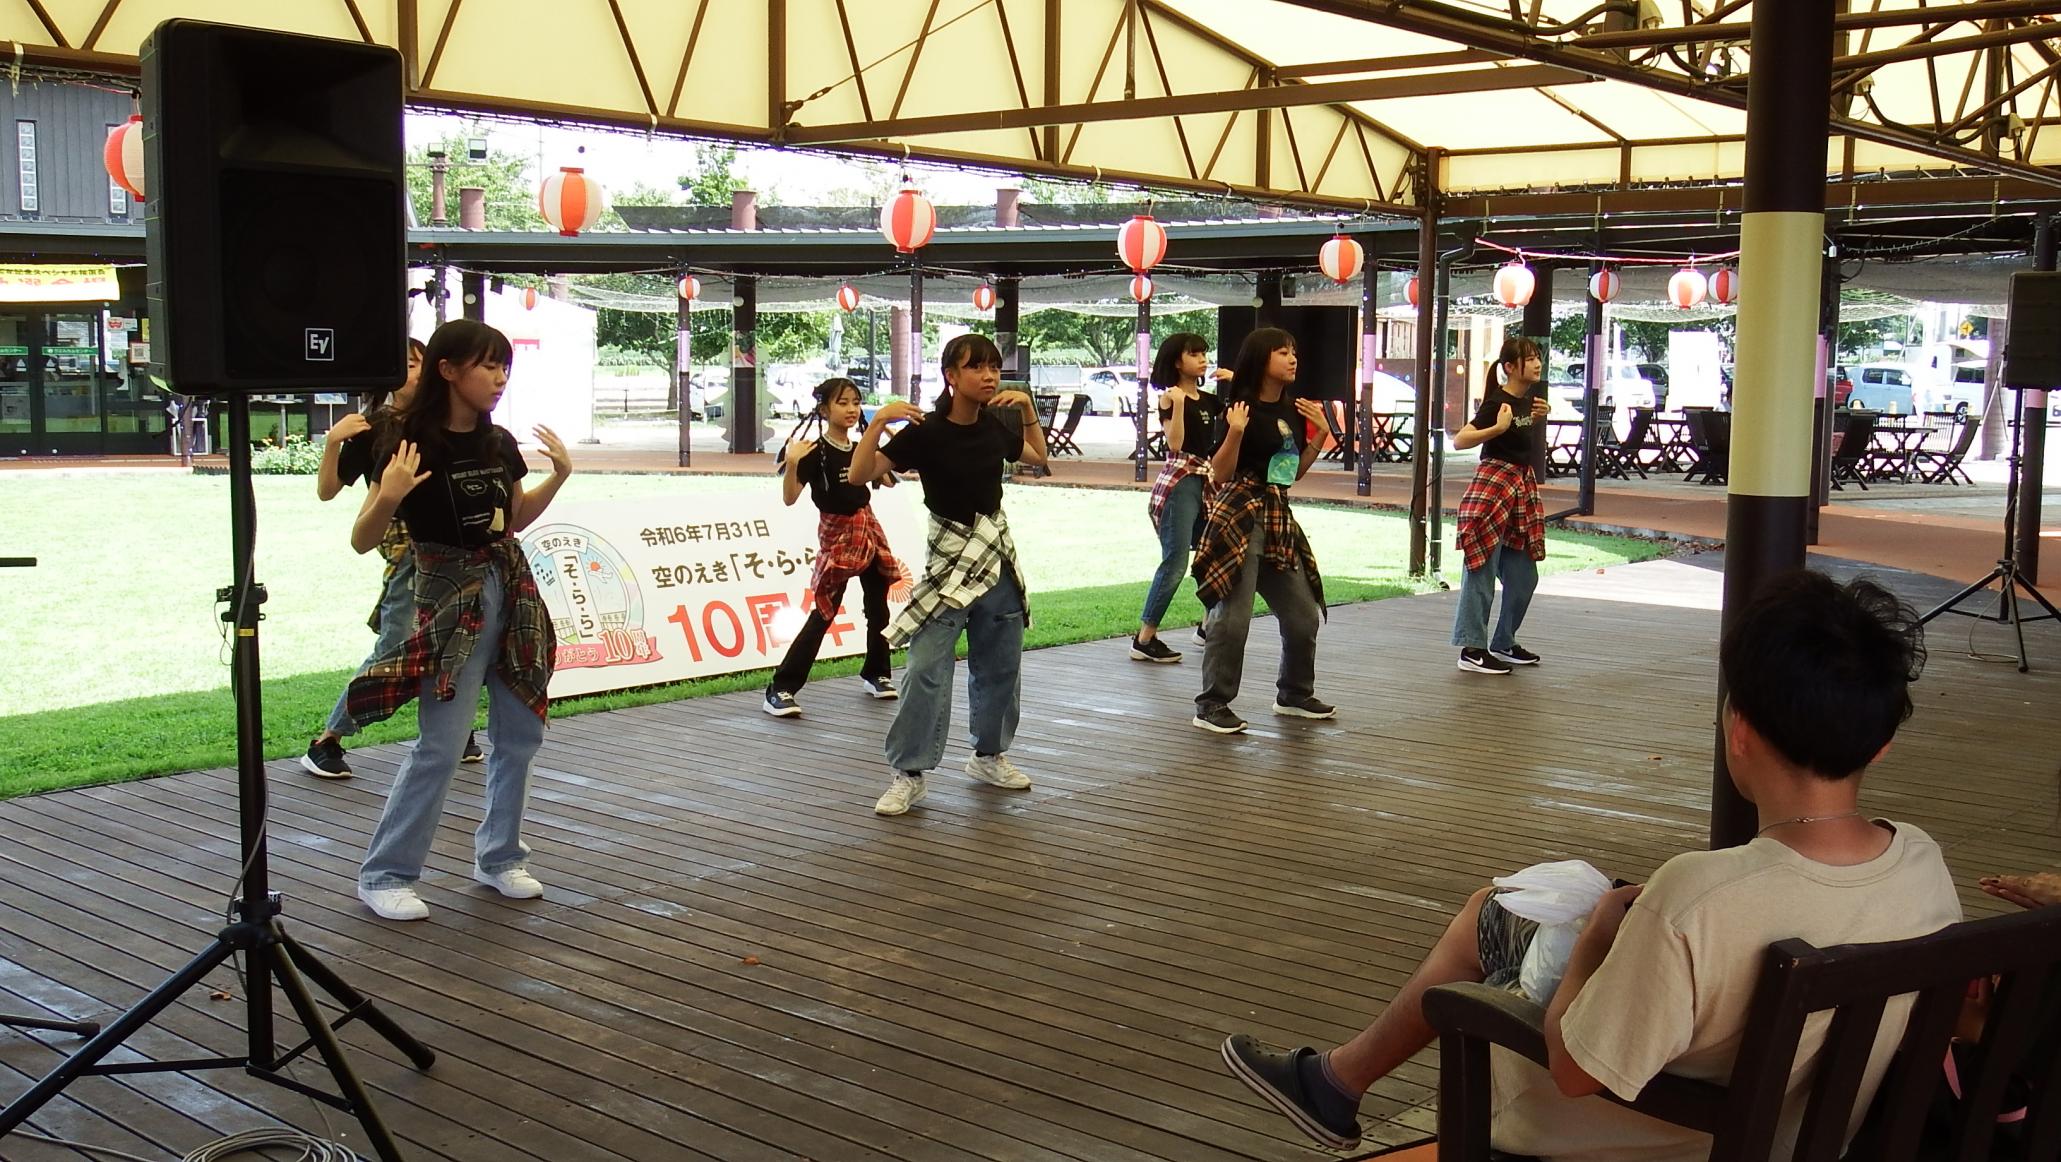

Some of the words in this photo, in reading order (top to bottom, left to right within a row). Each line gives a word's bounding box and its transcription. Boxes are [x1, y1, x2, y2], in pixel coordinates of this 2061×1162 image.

[541, 536, 582, 551] 空のえき
[639, 519, 770, 548] 令和6年7月31日
